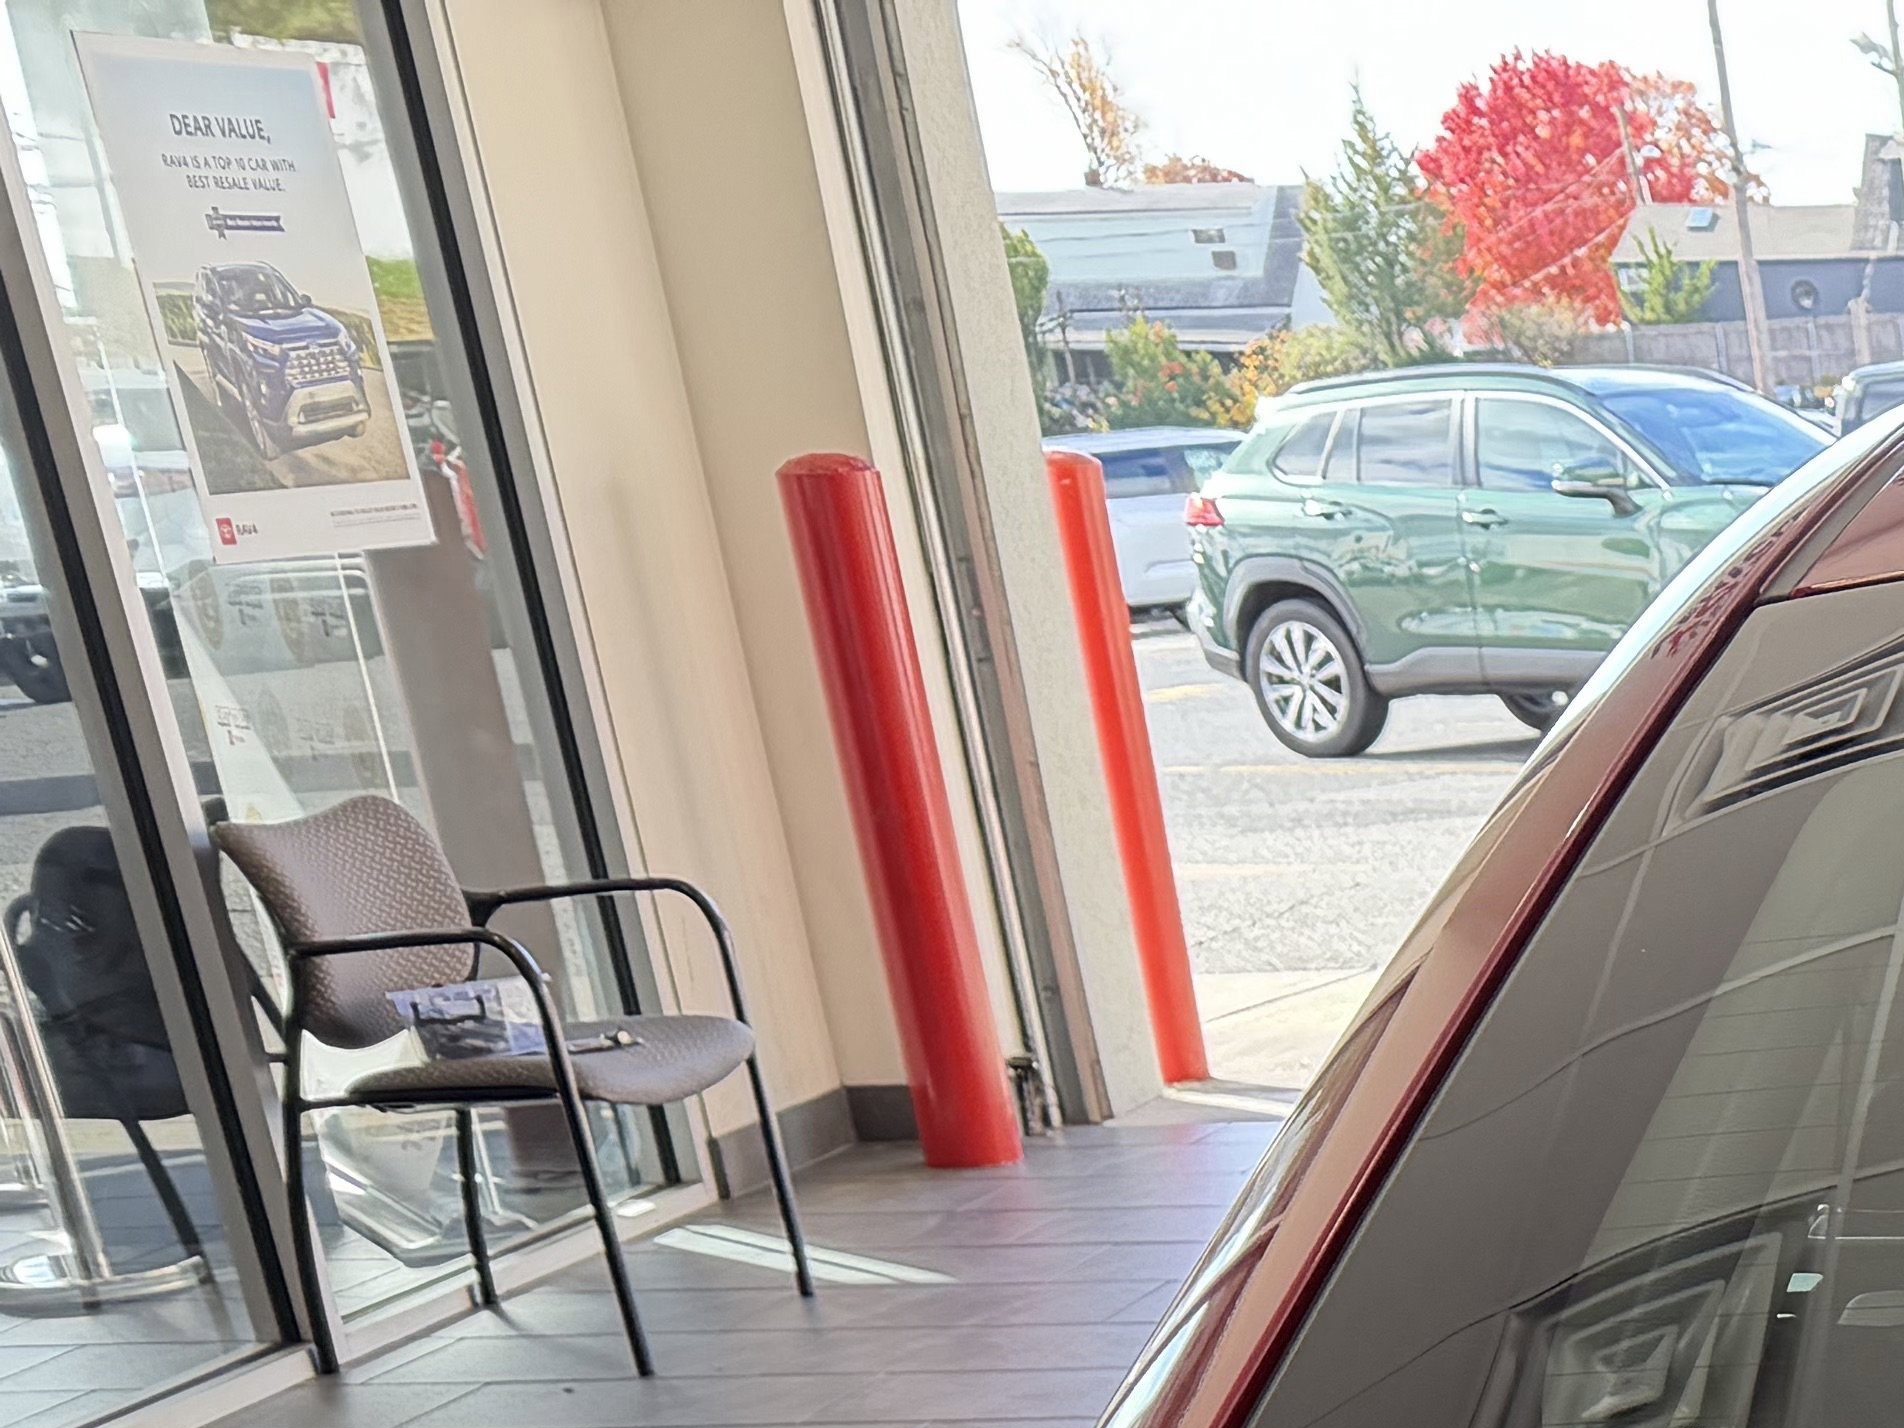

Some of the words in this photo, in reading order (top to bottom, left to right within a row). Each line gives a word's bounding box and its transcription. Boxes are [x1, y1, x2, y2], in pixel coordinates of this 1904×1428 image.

[169, 114, 215, 138] DEAR
[215, 117, 271, 144] VALUE,
[190, 155, 201, 169] IS
[203, 156, 212, 169] A
[211, 156, 232, 170] TOP
[247, 158, 269, 172] CAR
[269, 159, 297, 172] WITH
[186, 175, 211, 188] BEST
[213, 176, 250, 190] RESALE
